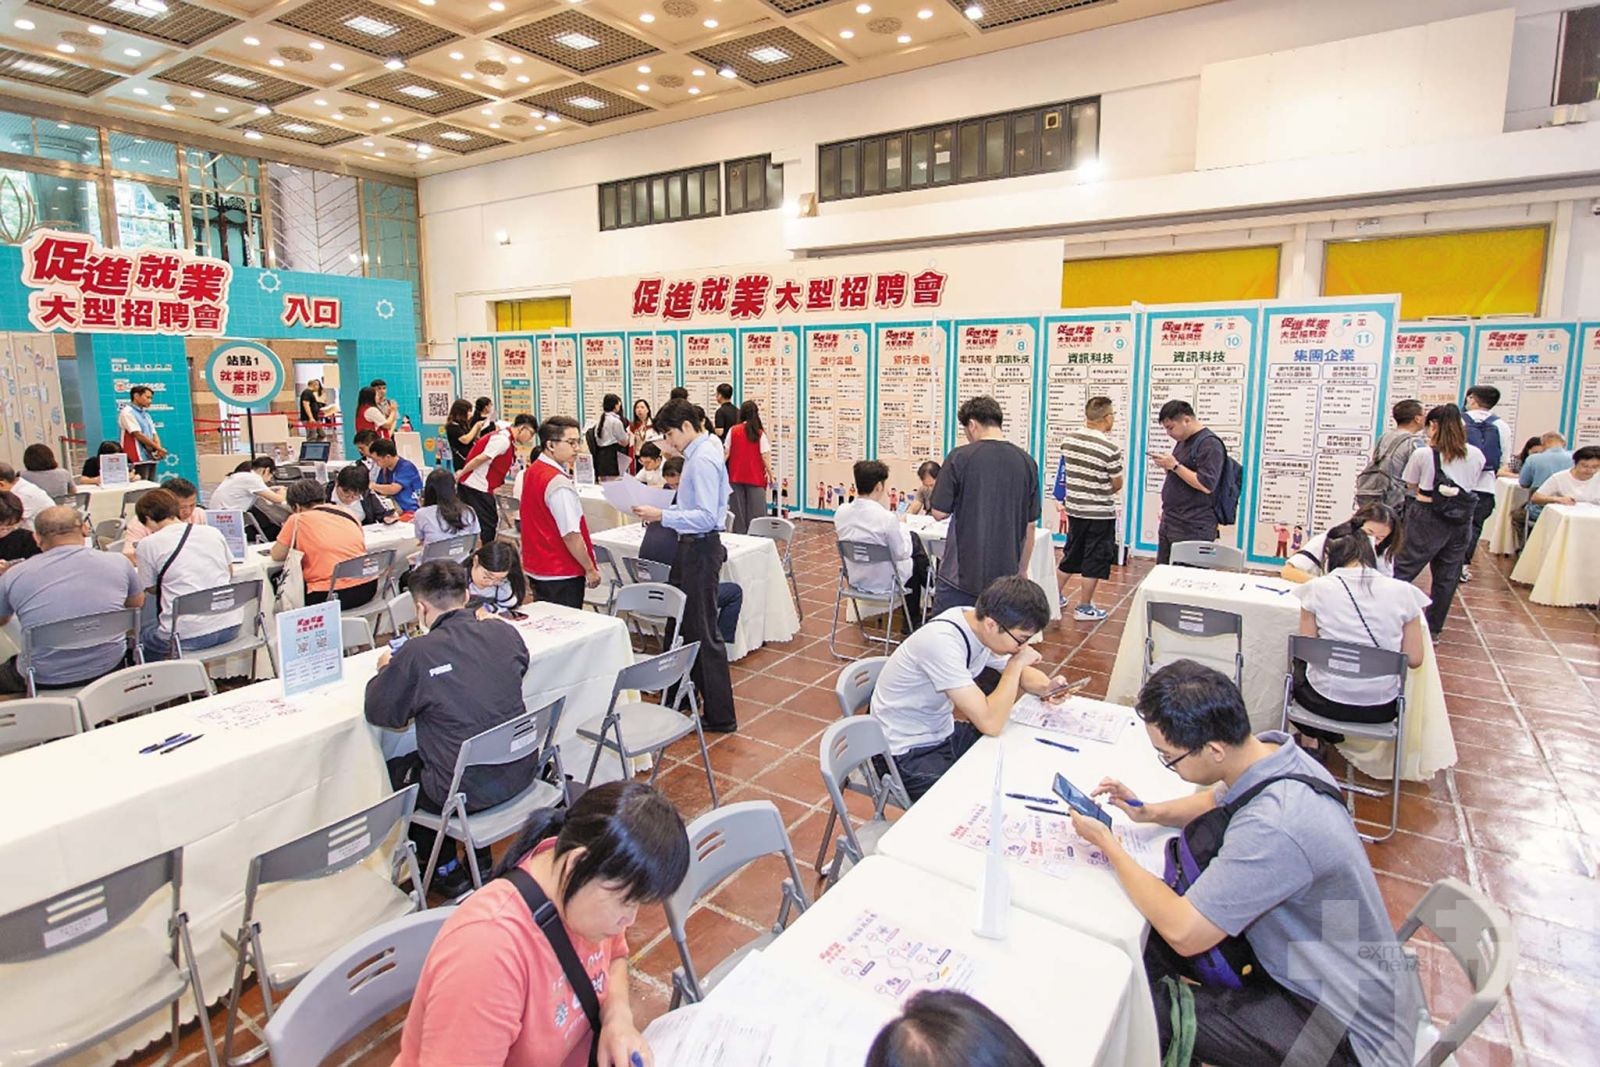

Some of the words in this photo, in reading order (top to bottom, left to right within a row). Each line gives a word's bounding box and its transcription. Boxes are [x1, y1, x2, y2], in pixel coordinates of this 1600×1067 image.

[33, 238, 224, 302] 促進就業
[633, 271, 945, 318] 促進就業大型招聘會
[40, 295, 221, 329] 大型招聘會
[285, 298, 337, 324] 入口
[1116, 339, 1124, 349] 9
[1227, 336, 1240, 347] 10
[1357, 335, 1370, 344] 11
[785, 345, 790, 353] 5
[854, 344, 859, 352] 6
[1018, 341, 1025, 351] 8
[1068, 353, 1114, 364] 資訊科技
[1173, 351, 1226, 363] 資訊科技
[1294, 349, 1355, 362] 集團企業
